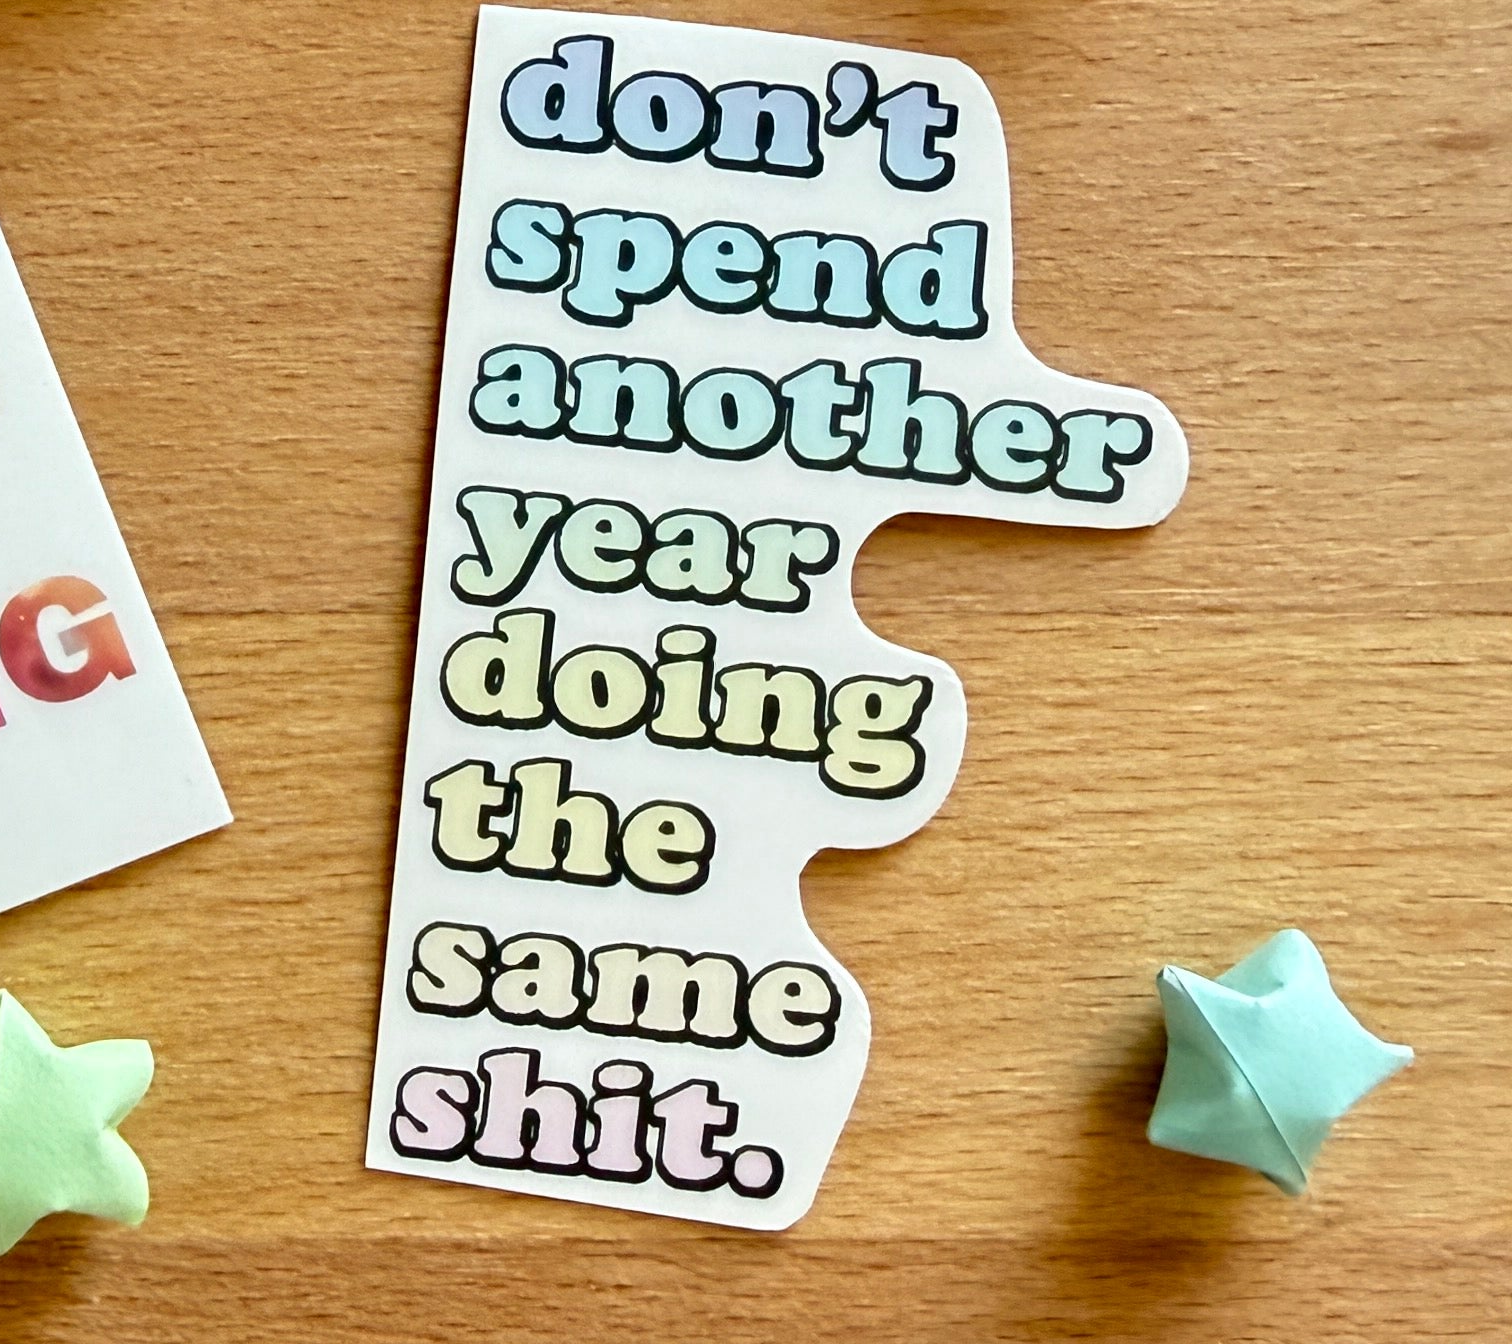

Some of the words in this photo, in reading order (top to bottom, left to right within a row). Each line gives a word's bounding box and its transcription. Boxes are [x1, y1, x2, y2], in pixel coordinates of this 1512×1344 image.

[501, 35, 958, 191] don’t
[488, 198, 988, 339] spend
[469, 343, 1152, 503] another
[451, 486, 839, 612] year
[441, 607, 932, 798] doing
[424, 757, 716, 894] the
[406, 921, 841, 1056] same
[390, 1047, 784, 1199] shit.
